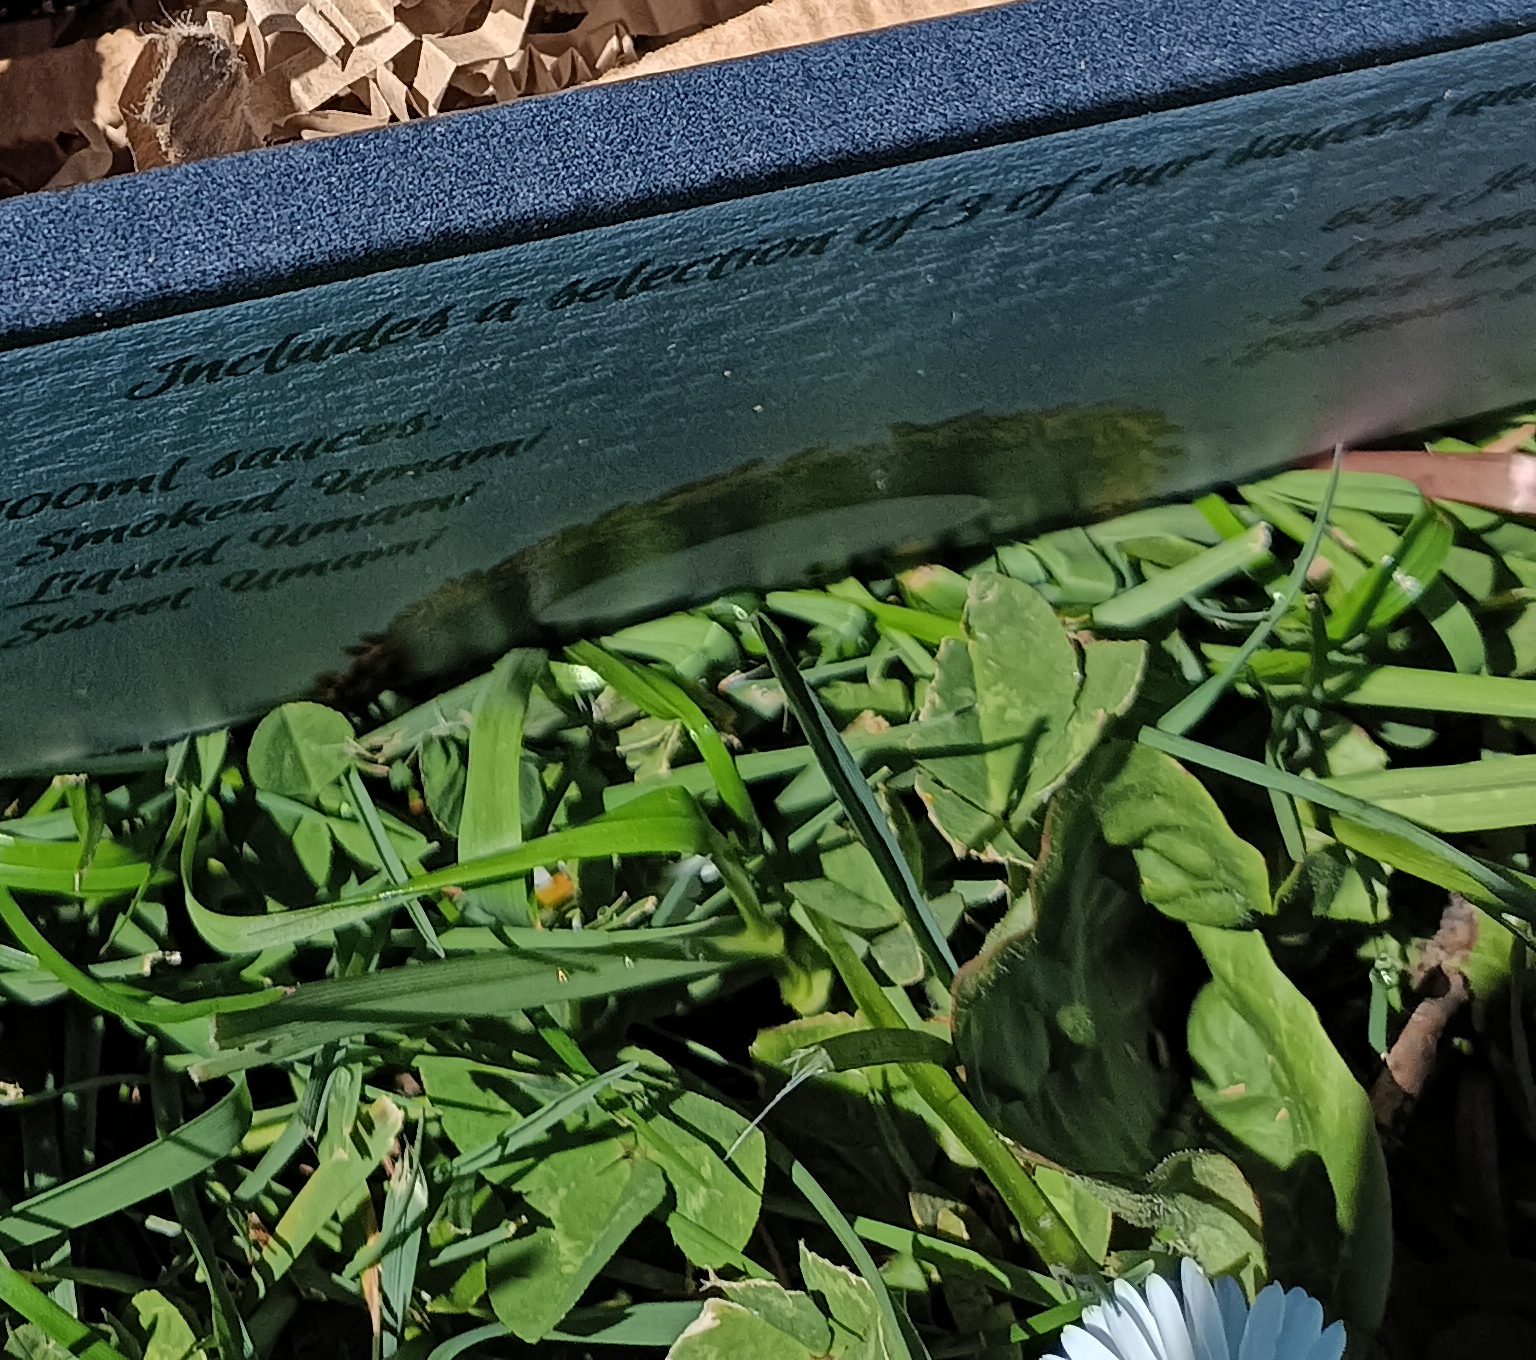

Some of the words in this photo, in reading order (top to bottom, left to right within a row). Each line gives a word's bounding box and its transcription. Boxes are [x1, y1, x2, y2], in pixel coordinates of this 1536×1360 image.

[125, 305, 451, 401] Includes
[474, 293, 528, 327] a
[544, 230, 840, 313] selection
[1005, 162, 1102, 219] of
[1445, 79, 1536, 118] an
[4, 534, 232, 611] Liquid
[246, 481, 486, 549] Umami
[15, 478, 296, 568] Smoked
[310, 426, 553, 496] Umami
[218, 526, 451, 592] Umami
